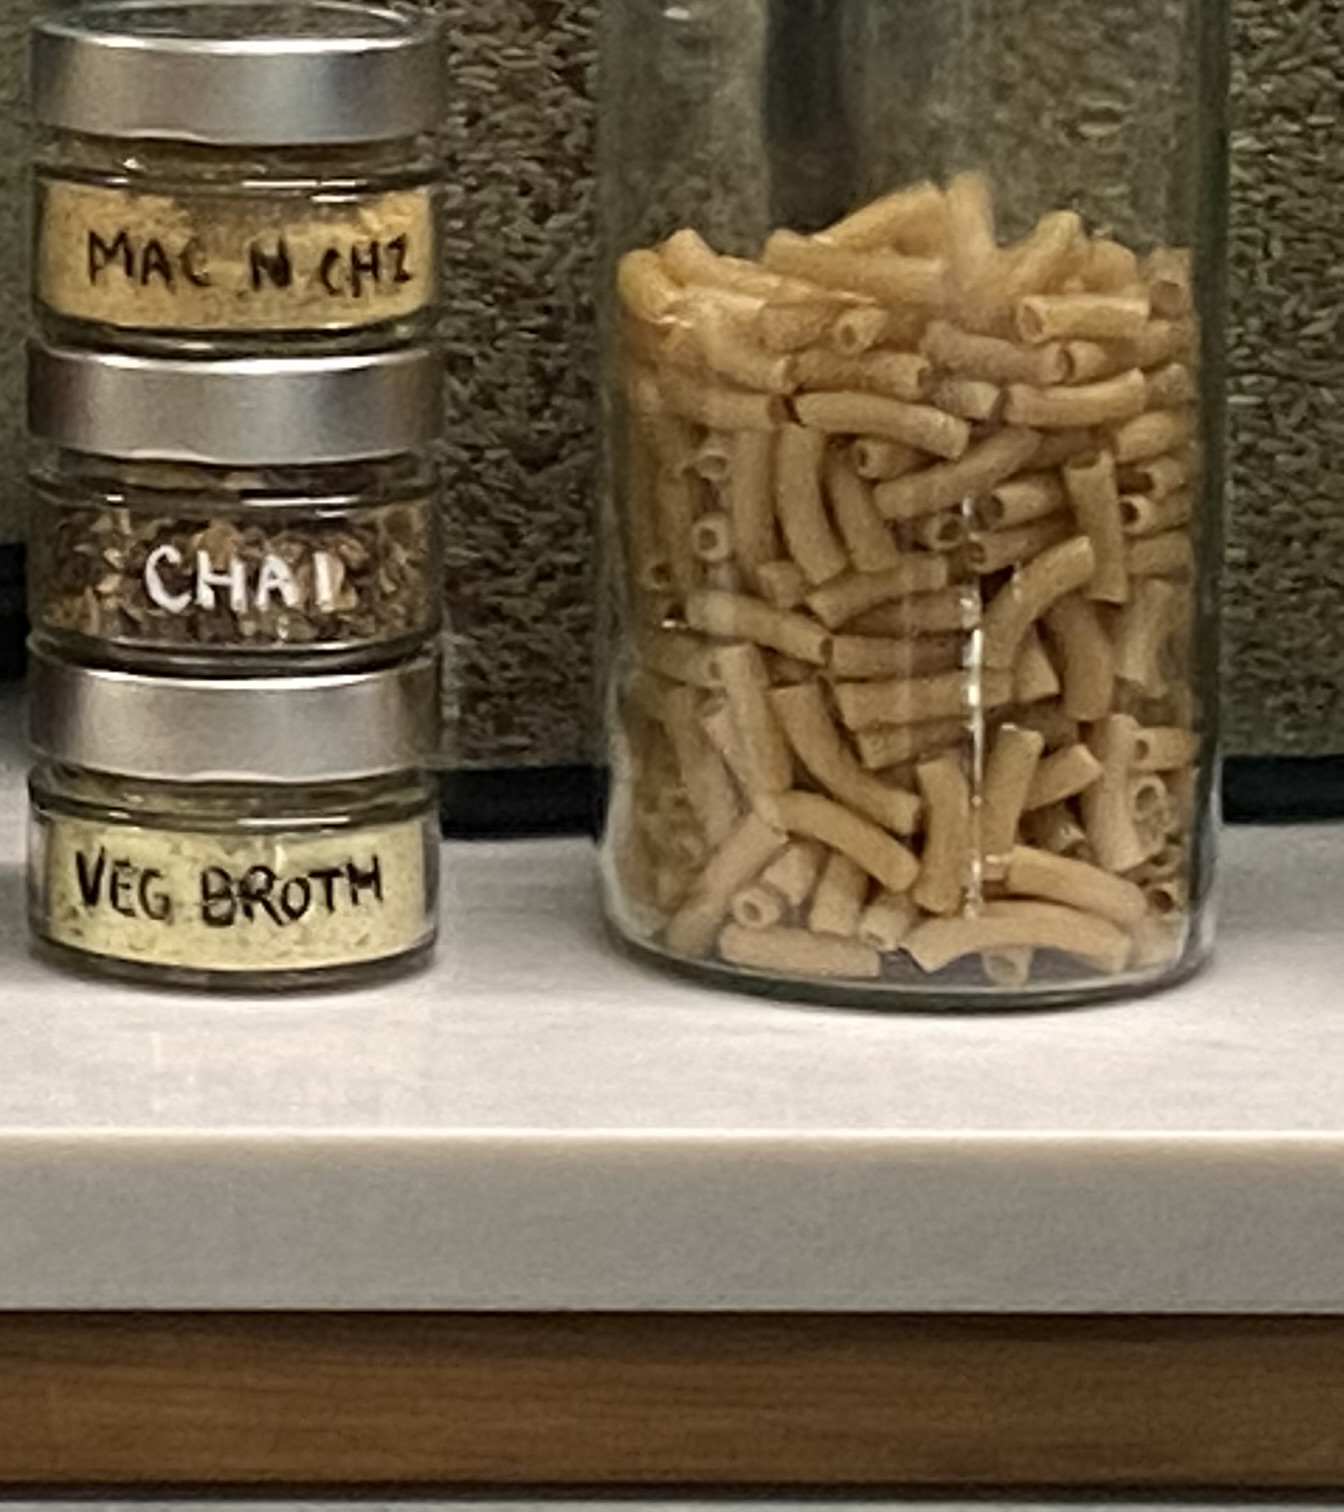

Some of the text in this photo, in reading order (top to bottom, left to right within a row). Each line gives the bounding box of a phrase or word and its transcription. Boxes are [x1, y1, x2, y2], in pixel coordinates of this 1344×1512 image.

[87, 228, 213, 288] MAC
[248, 234, 294, 290] N
[145, 545, 336, 613] CHAI
[75, 846, 383, 929] VEG BROTH
